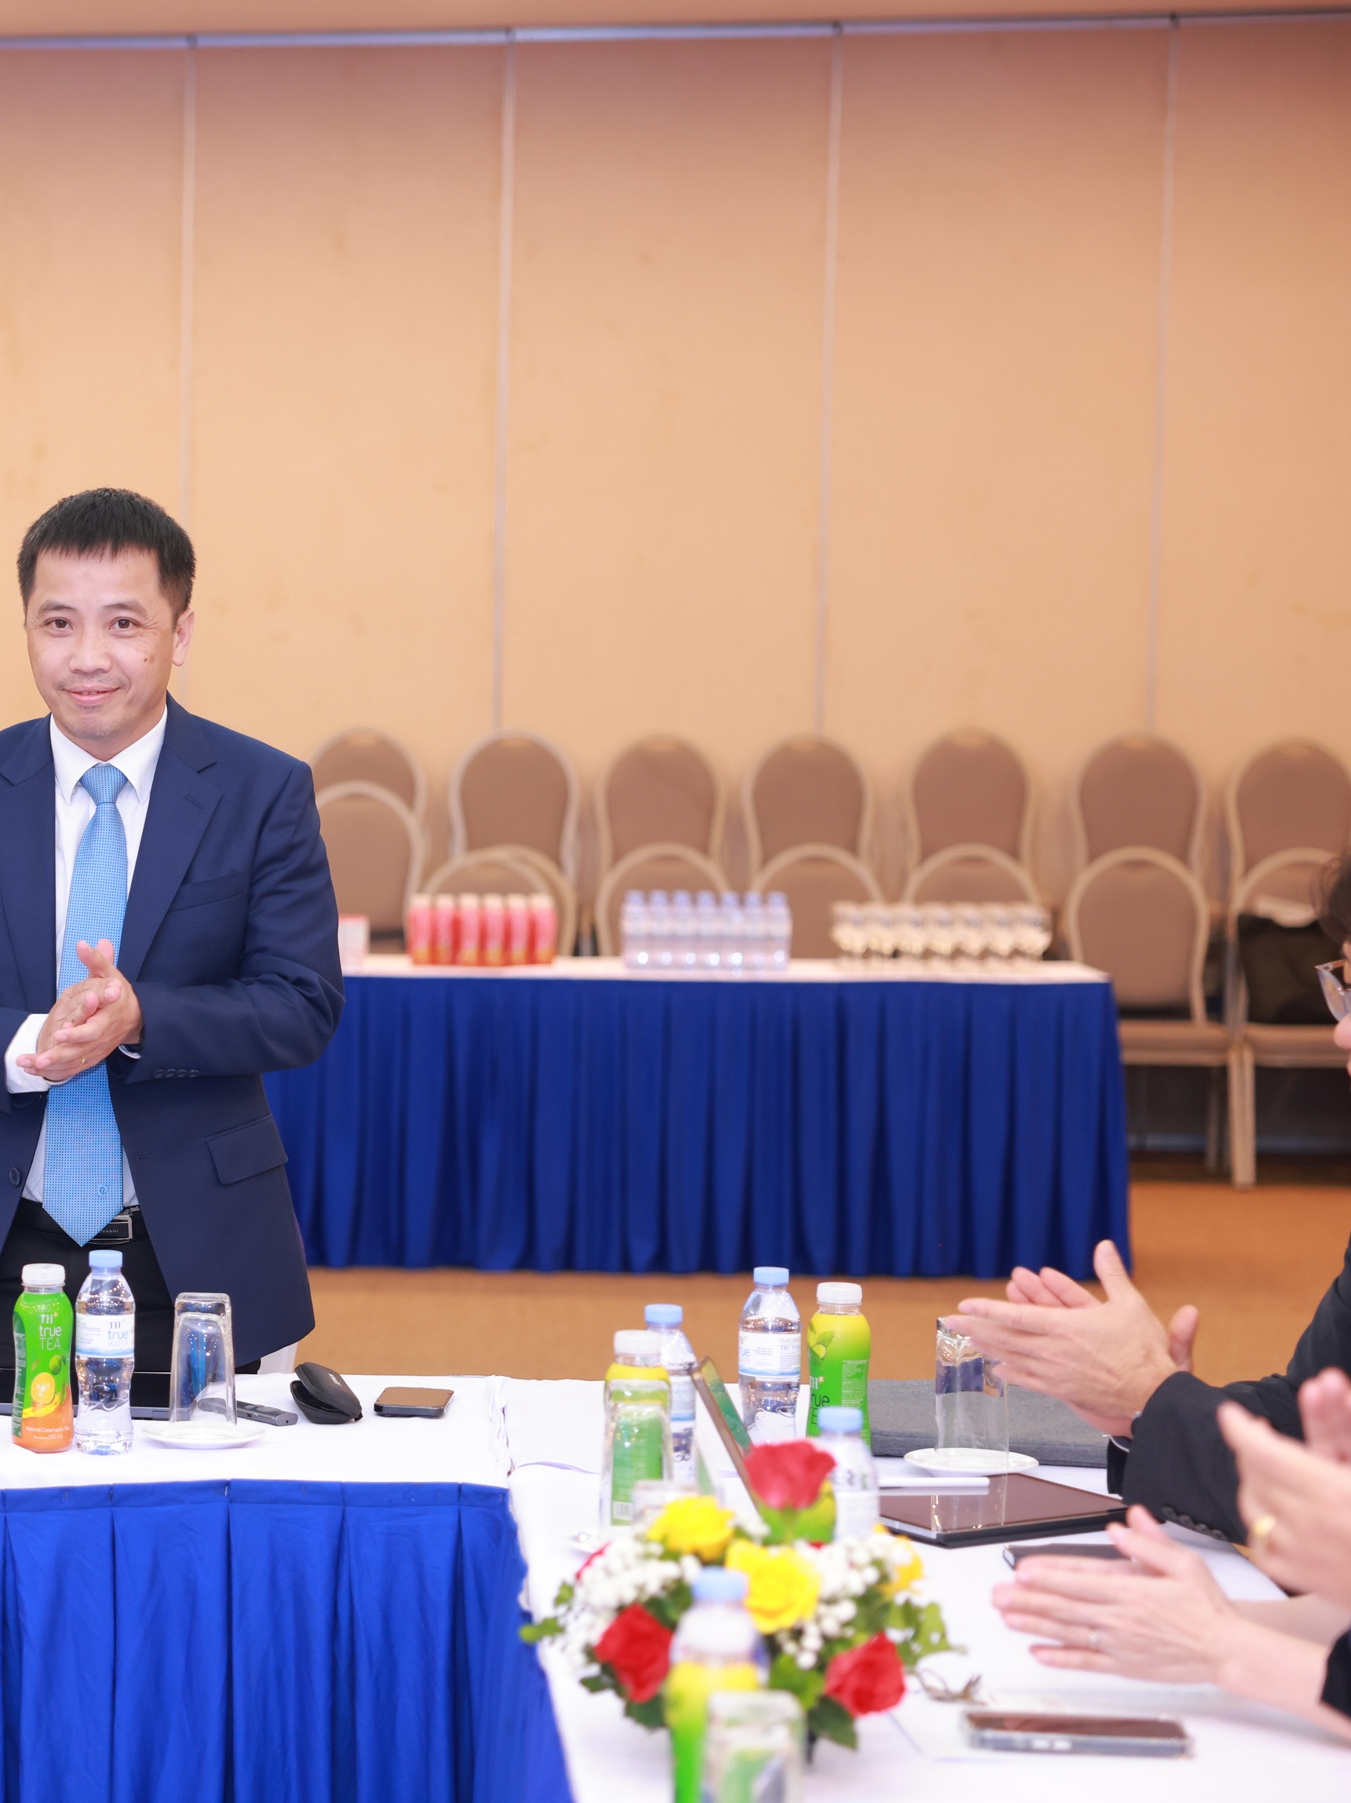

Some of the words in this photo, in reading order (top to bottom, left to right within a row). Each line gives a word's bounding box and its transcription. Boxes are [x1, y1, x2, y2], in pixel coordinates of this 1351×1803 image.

[40, 1314, 53, 1324] TH
[107, 1321, 121, 1329] TH
[39, 1324, 62, 1337] true
[107, 1330, 129, 1340] true
[39, 1337, 61, 1350] TEA
